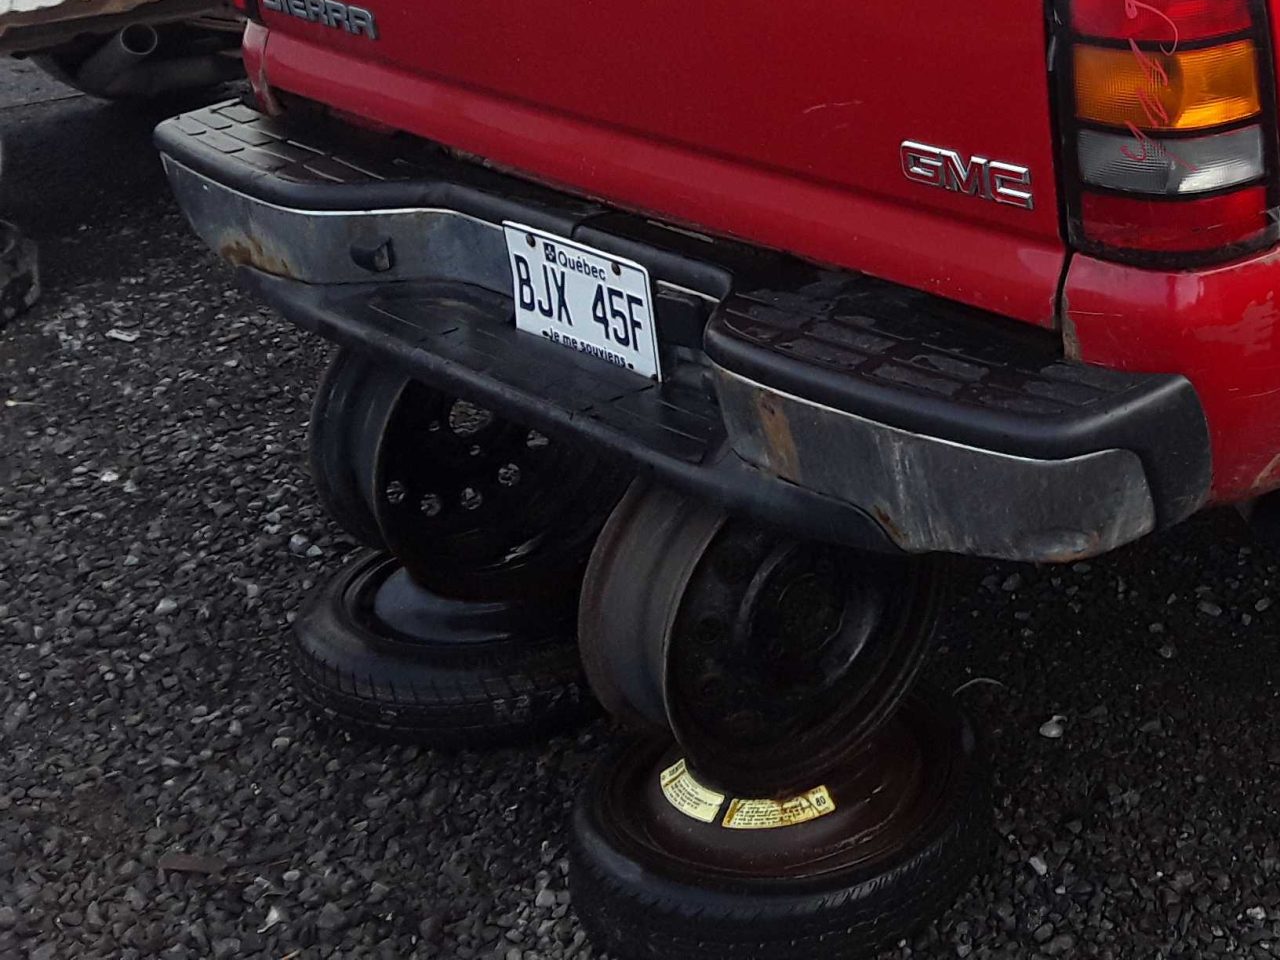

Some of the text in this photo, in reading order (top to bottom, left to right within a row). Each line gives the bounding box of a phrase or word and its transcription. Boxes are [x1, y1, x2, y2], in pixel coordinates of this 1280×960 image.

[900, 140, 1035, 210] GMC
[557, 250, 607, 282] Québec
[514, 253, 643, 352] BJX 45F
[562, 335, 578, 349] me
[580, 341, 626, 368] souviens
